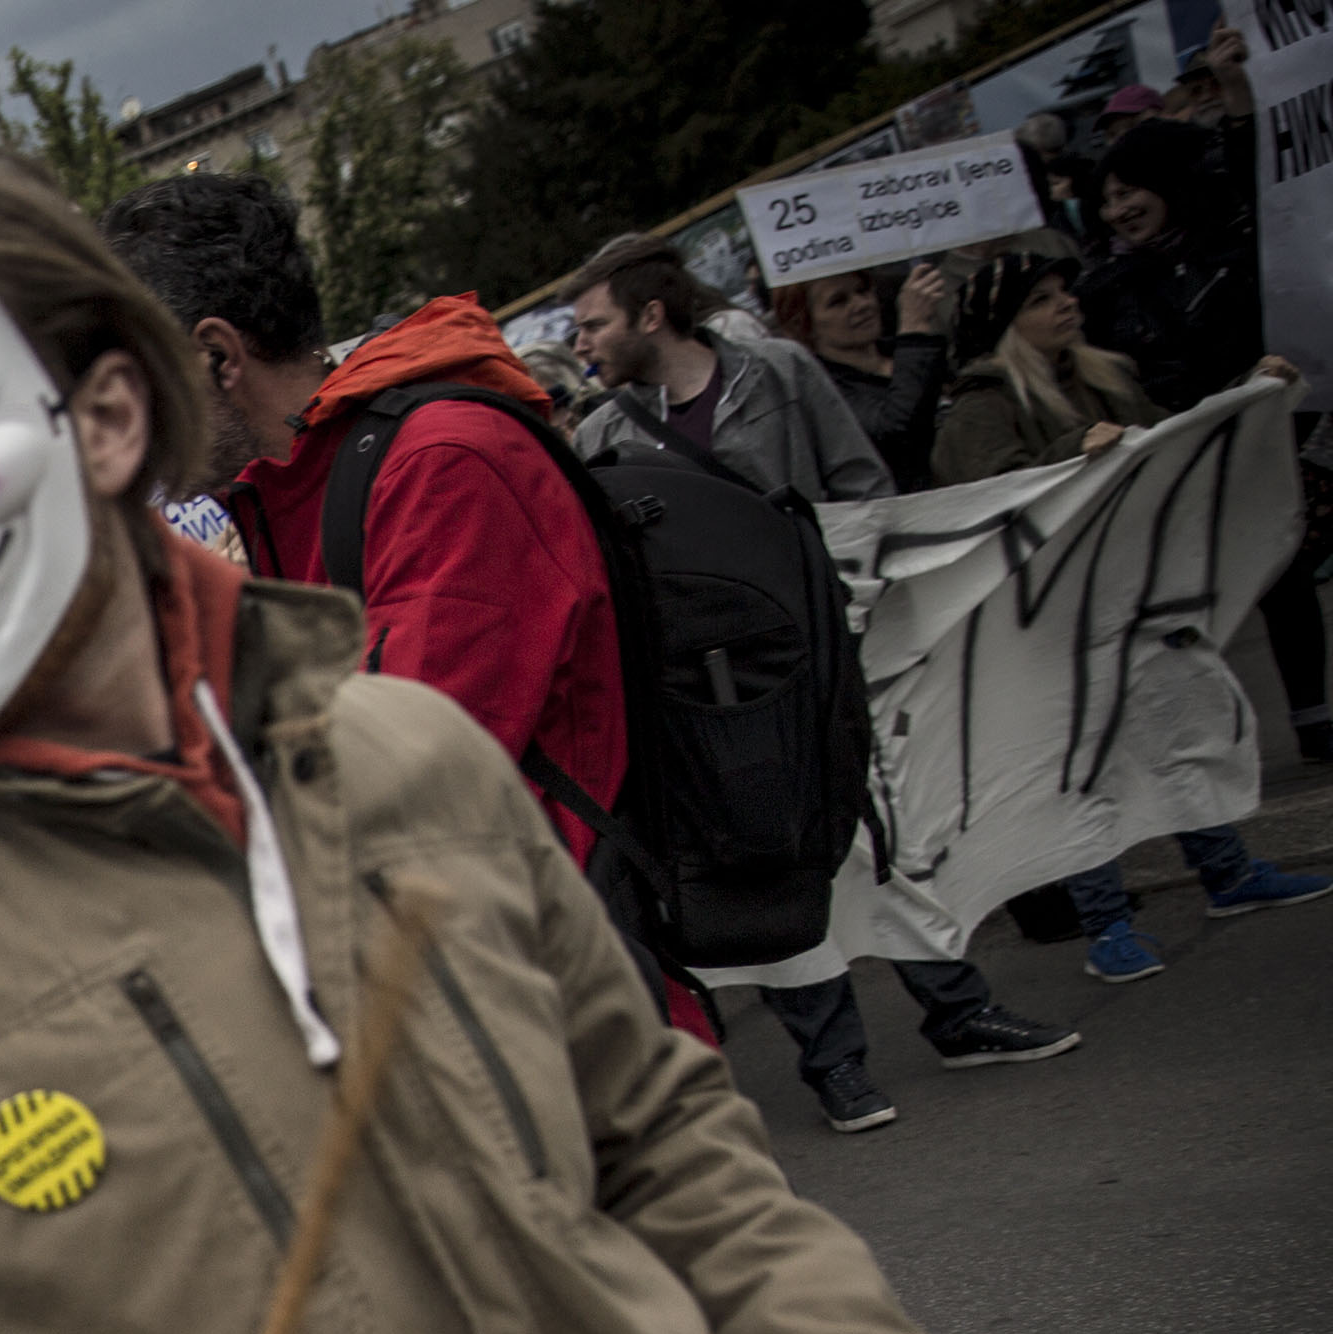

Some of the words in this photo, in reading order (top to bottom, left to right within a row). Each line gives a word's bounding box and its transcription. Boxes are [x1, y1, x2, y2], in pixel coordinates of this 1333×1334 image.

[769, 193, 817, 232] 25
[858, 166, 952, 200] zaborav
[772, 233, 854, 274] godina
